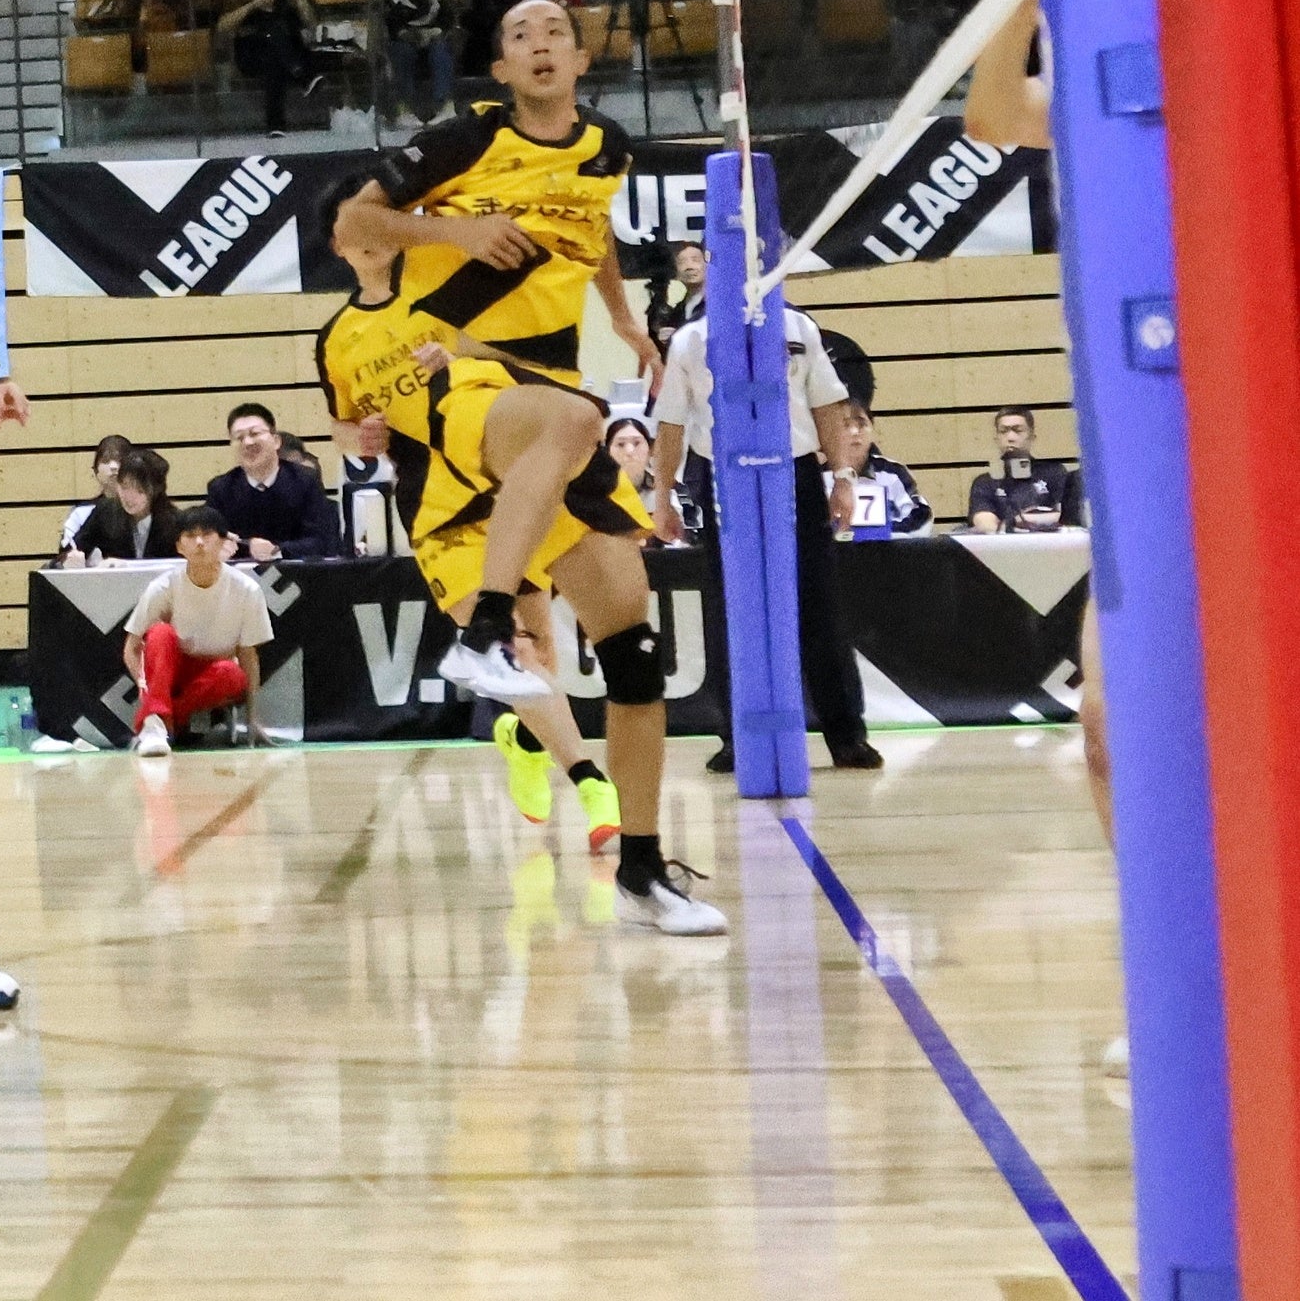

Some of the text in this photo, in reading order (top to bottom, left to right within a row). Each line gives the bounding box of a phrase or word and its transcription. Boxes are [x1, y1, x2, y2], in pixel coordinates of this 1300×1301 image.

[138, 154, 293, 297] LEAGUE
[862, 137, 1012, 267] LEAGU
[858, 495, 874, 521] 7
